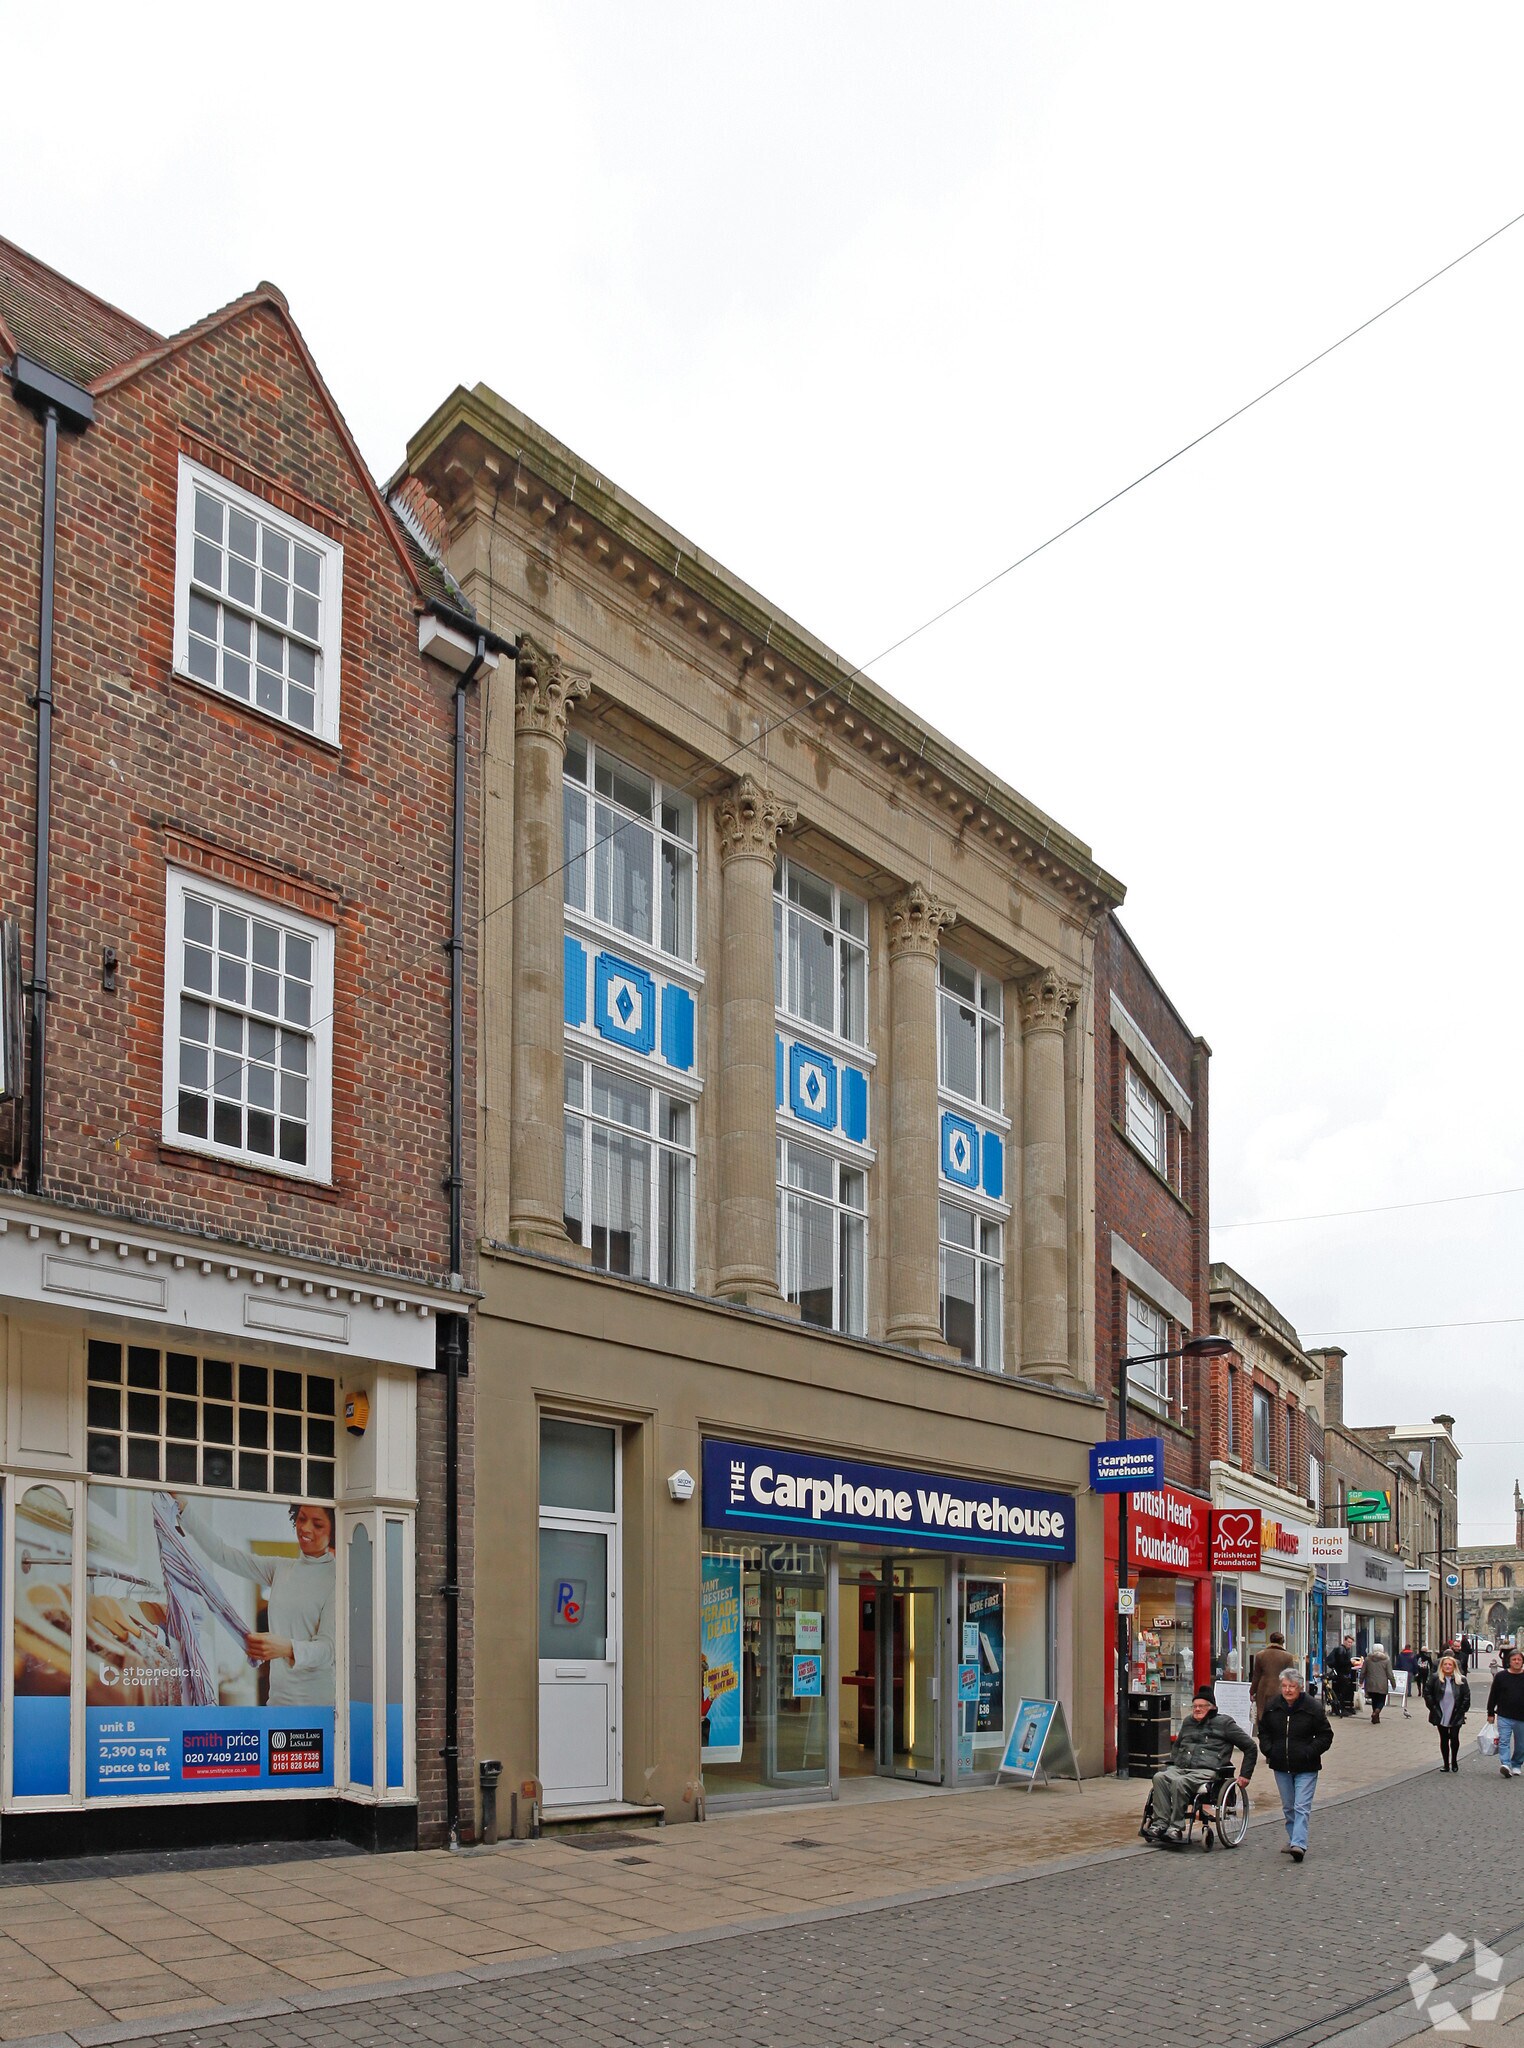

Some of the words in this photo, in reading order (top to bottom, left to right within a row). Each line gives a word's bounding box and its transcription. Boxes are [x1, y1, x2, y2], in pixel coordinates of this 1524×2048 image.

[1102, 1454, 1154, 1466] Carphone
[1098, 1466, 1154, 1477] Warehouse
[730, 1460, 745, 1503] THE
[750, 1465, 913, 1521] Carphone
[917, 1489, 1065, 1538] Warehouse
[1133, 1490, 1165, 1519] British
[1167, 1493, 1192, 1529] Heart
[1135, 1525, 1189, 1567] Foundation
[1312, 1536, 1343, 1546] Bright
[1312, 1547, 1343, 1555] House
[969, 1599, 984, 1614] HERE
[984, 1593, 1000, 1608] FIRST
[702, 1598, 739, 1622] GRADE
[707, 1615, 738, 1641] DEAL?
[123, 1666, 134, 1677] st
[137, 1666, 201, 1677] benedicts
[123, 1677, 159, 1686] court
[100, 1721, 124, 1732] unit
[127, 1721, 135, 1732] B
[184, 1733, 223, 1748] smith
[226, 1732, 259, 1749] price
[100, 1746, 136, 1759] 2,390
[140, 1747, 153, 1759] sq
[156, 1746, 167, 1756] ft
[185, 1753, 204, 1763] 020
[207, 1752, 231, 1762] 7409
[234, 1752, 258, 1762] 2100
[273, 1753, 288, 1761] 0151
[290, 1753, 302, 1761] 236
[304, 1752, 319, 1760] 7336
[99, 1763, 135, 1775] space
[138, 1762, 151, 1772] to
[154, 1761, 171, 1772] let
[197, 1767, 247, 1775] www.smithprice.co.uk
[273, 1762, 288, 1770] 0161
[290, 1762, 302, 1770] 828
[304, 1761, 319, 1769] 6440
